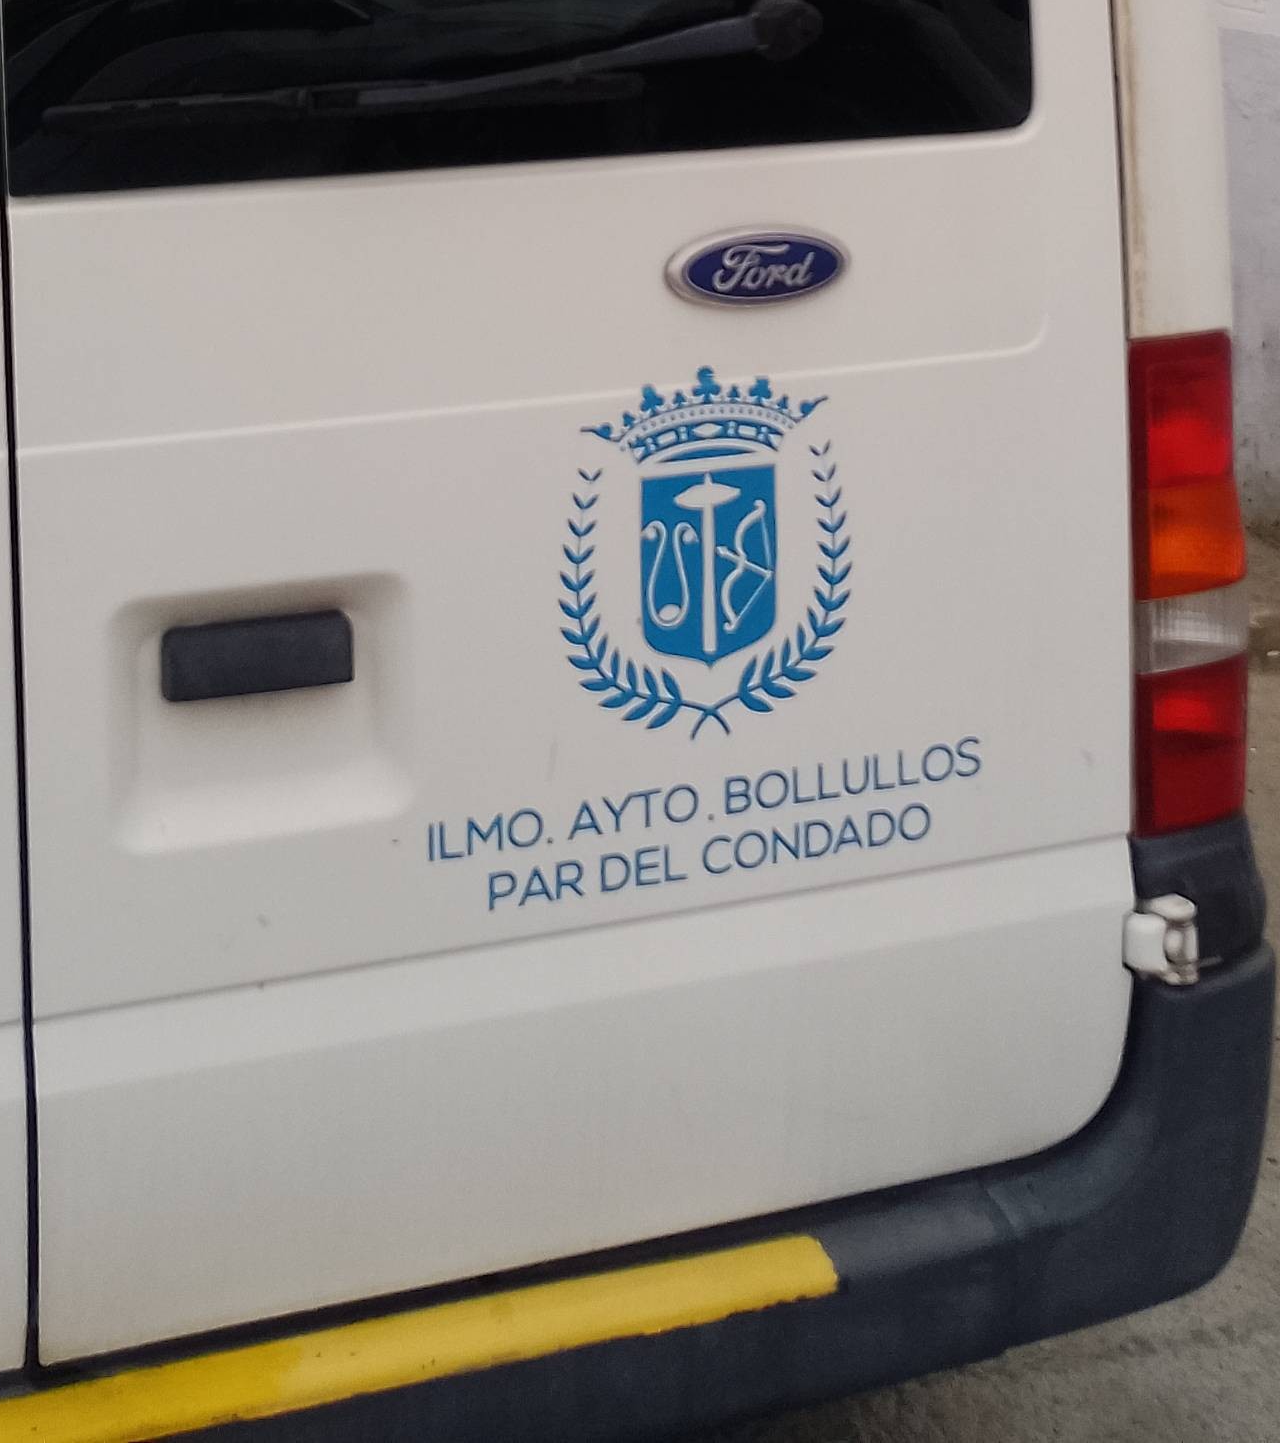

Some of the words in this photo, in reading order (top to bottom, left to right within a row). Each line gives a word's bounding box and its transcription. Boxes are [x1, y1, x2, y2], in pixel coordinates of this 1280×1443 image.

[712, 243, 815, 292] Ford
[428, 808, 554, 861] ILMO.
[725, 735, 981, 815] BOLLULLOS
[488, 859, 585, 911] PAR
[600, 844, 688, 892] DEL
[702, 803, 930, 874] CONDADO
